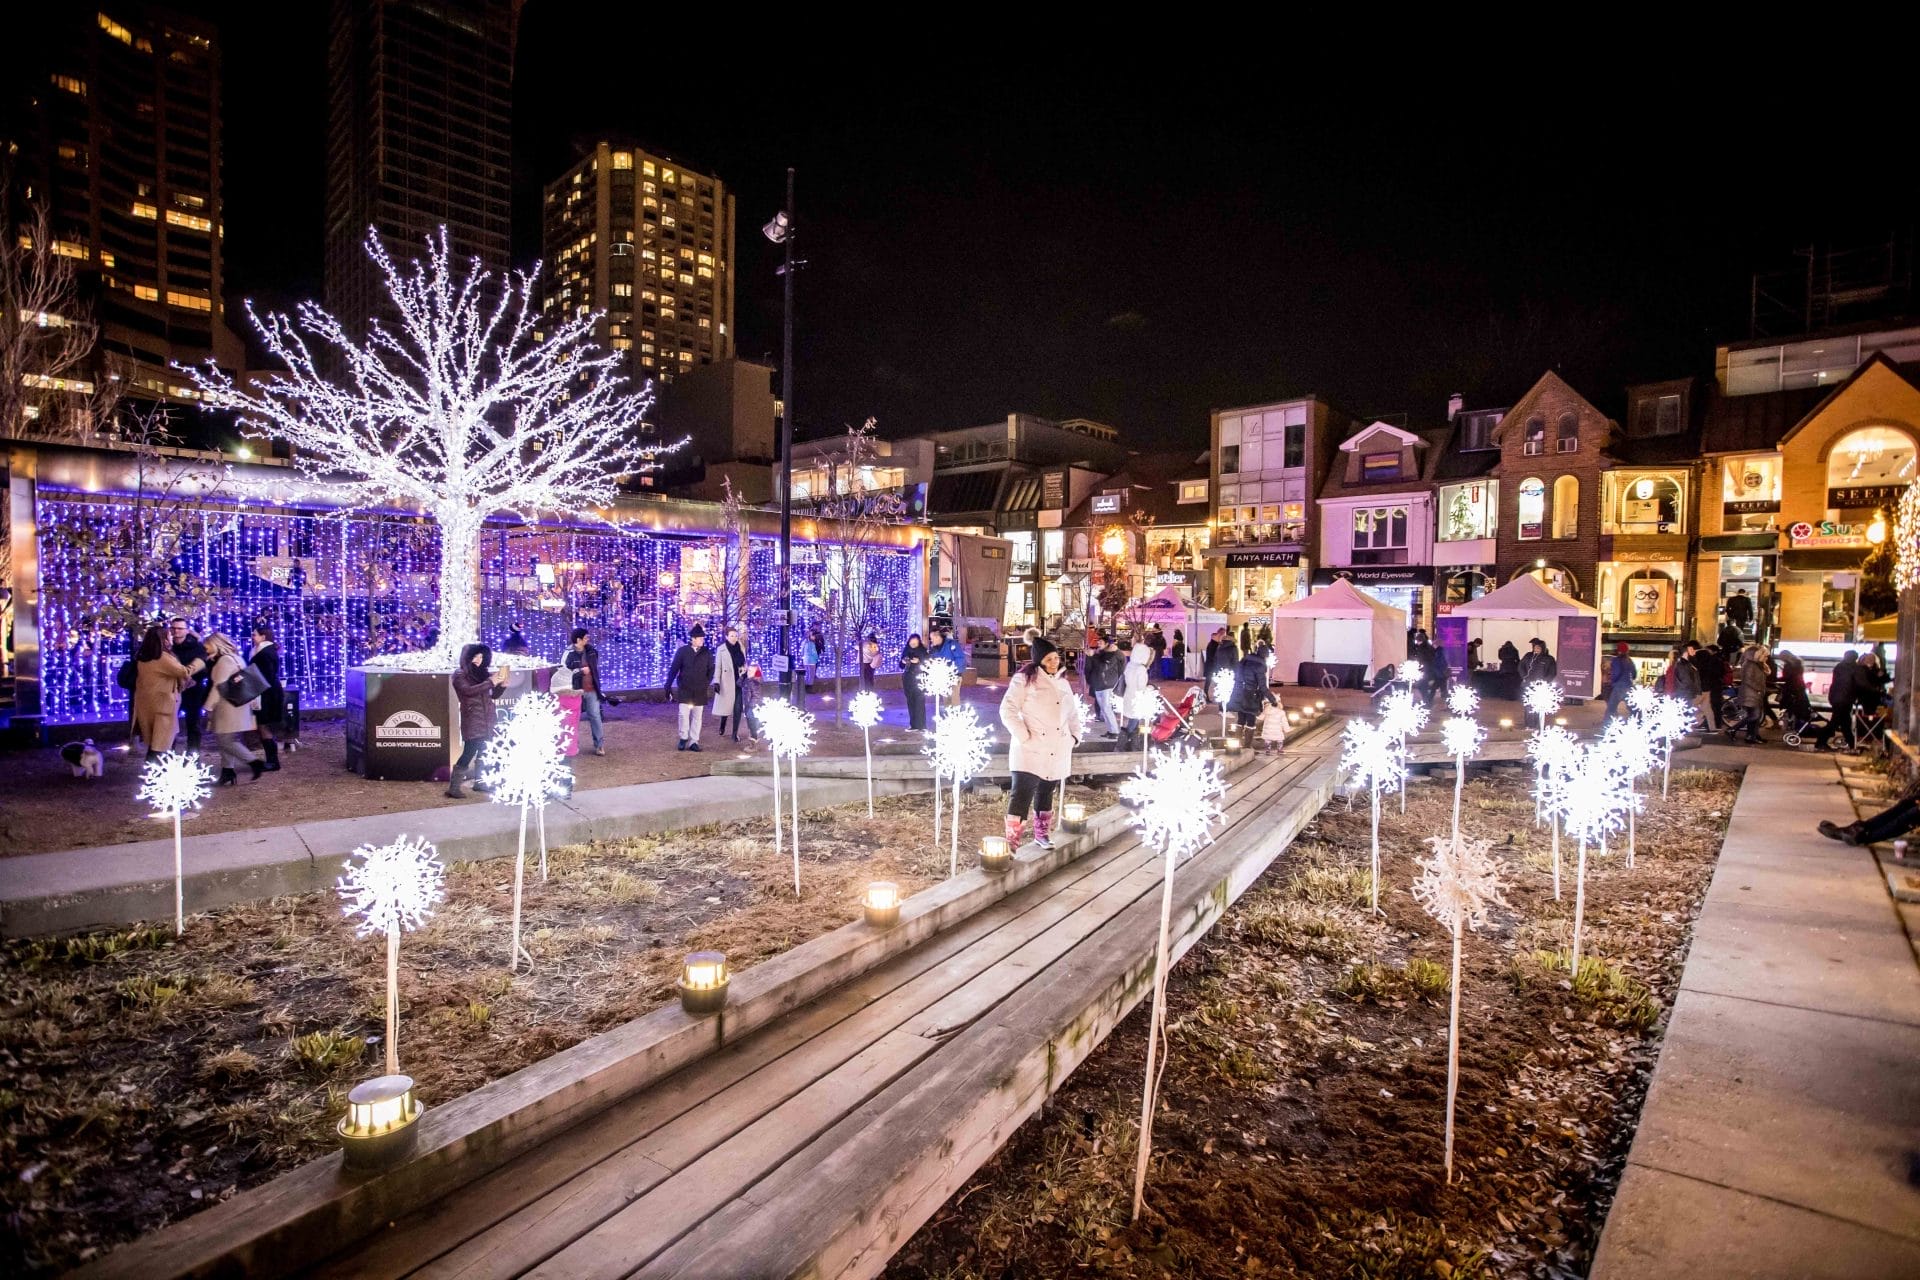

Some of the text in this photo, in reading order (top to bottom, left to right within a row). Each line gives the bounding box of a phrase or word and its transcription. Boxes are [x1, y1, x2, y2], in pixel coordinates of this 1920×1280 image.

[1232, 553, 1294, 562] TANYA HEATH
[1381, 572, 1415, 580] Eyewear
[392, 713, 424, 725] BLOOR
[382, 728, 436, 736] YORKVILLE
